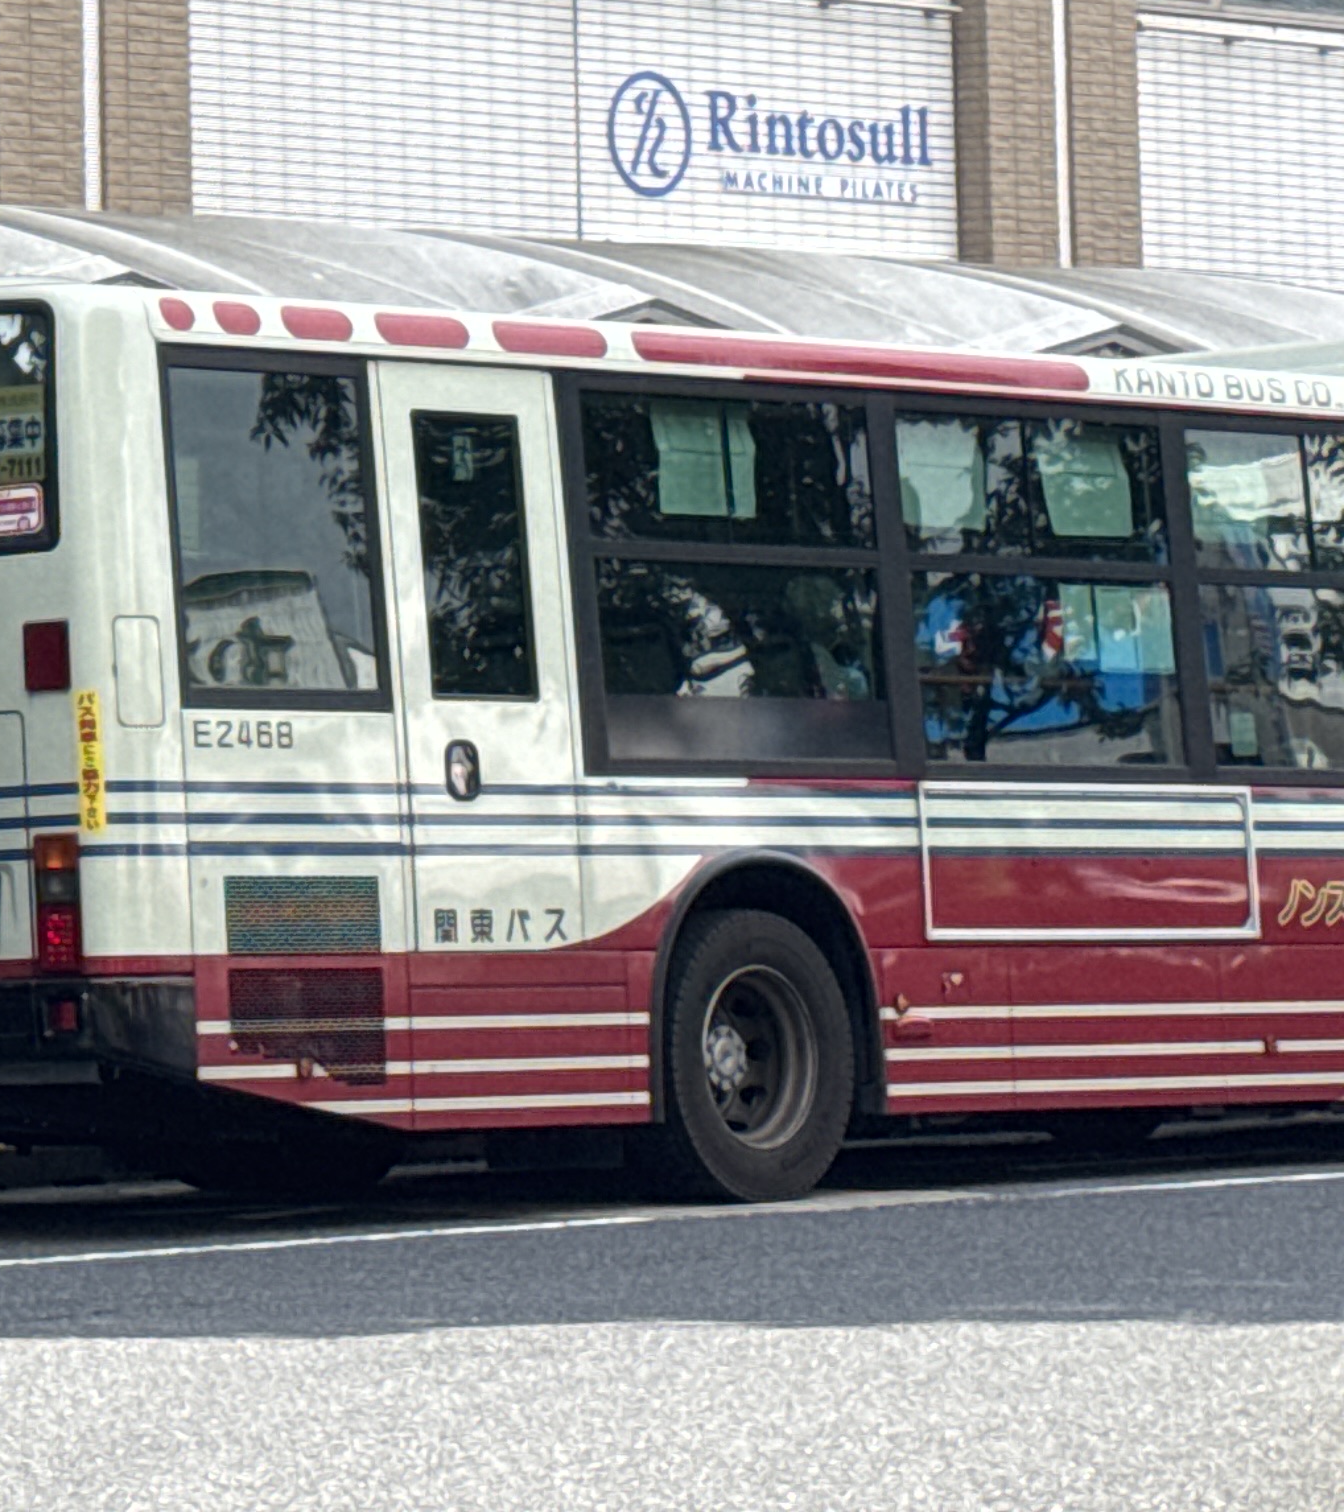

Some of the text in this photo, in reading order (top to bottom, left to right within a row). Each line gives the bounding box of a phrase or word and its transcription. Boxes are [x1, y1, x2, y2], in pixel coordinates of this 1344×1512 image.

[706, 90, 933, 167] Rintosull
[724, 170, 918, 203] MACHINE PILATES
[1114, 367, 1214, 399] KANTO
[1224, 374, 1287, 405] BUS
[193, 719, 294, 749] E2468
[434, 908, 568, 943] 関東バス
